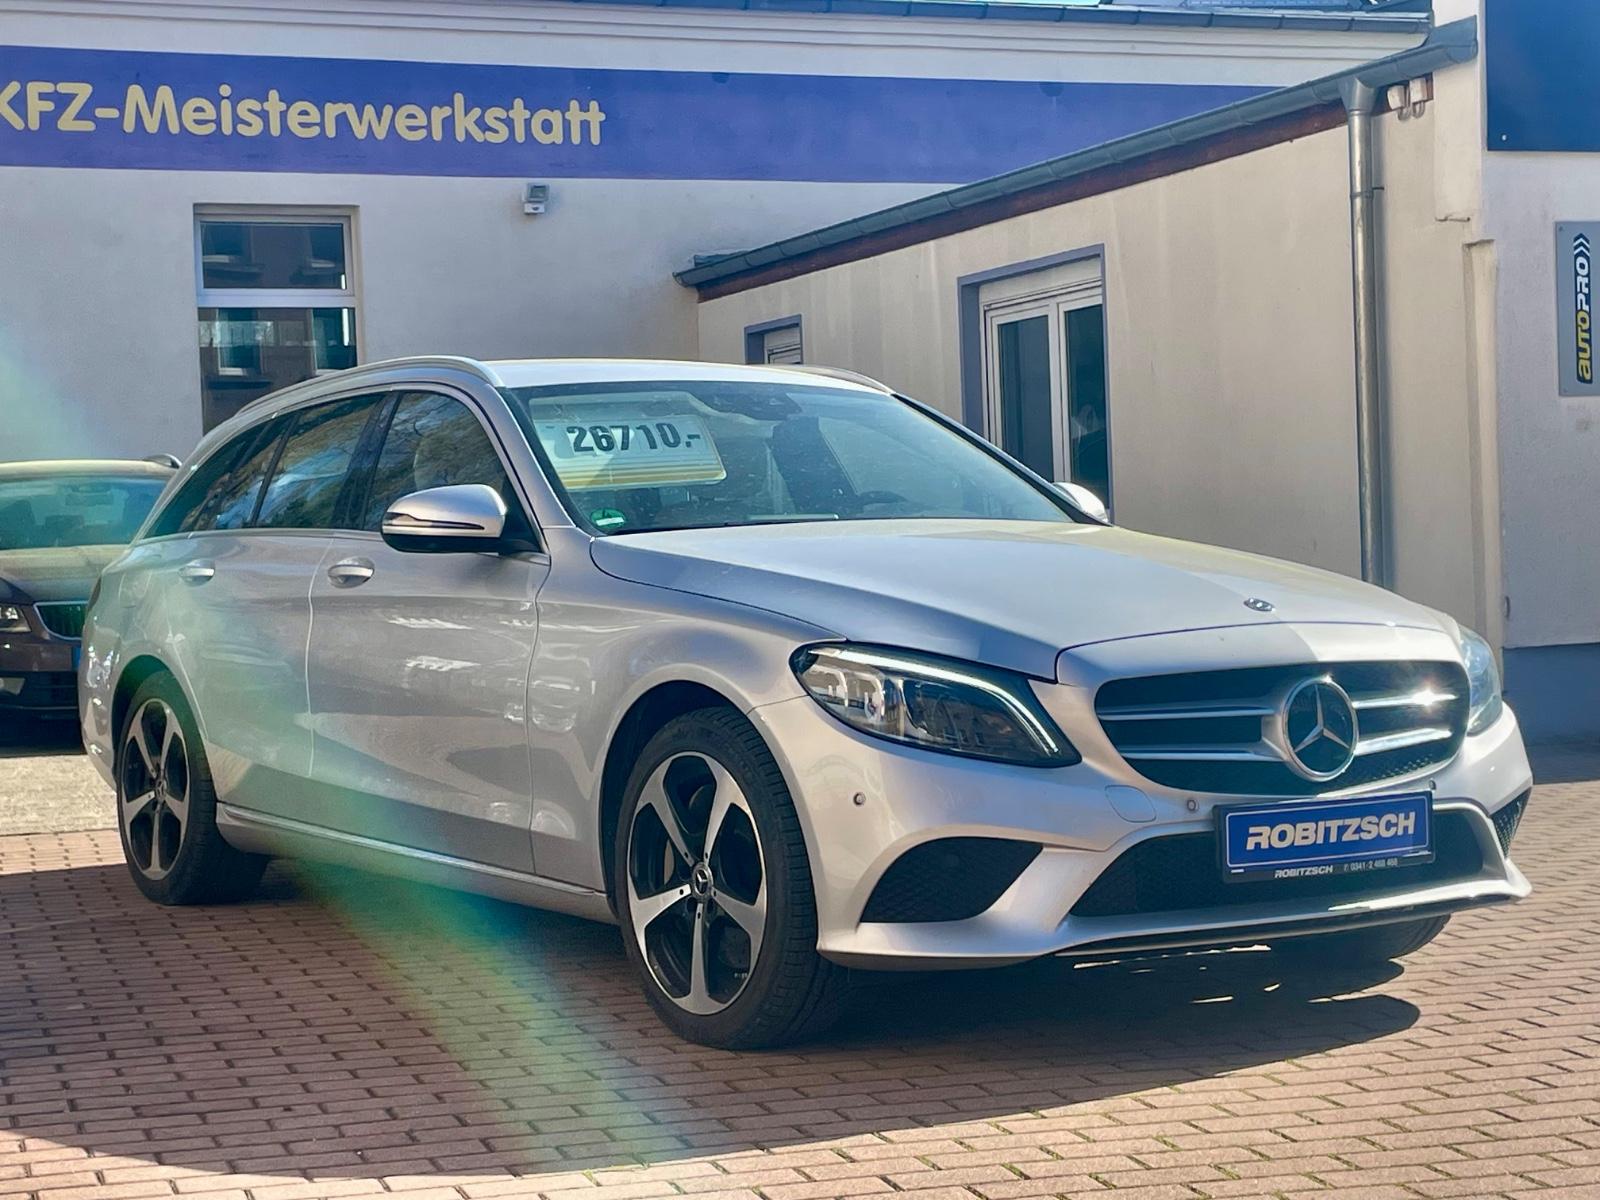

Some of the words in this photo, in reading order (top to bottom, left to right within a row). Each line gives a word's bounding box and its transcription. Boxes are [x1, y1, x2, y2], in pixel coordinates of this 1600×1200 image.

[0, 81, 606, 146] KFZ-Meisterwerkstatt
[1246, 811, 1416, 850] ROBITZSCH
[1274, 865, 1333, 878] ROBITZSCH
